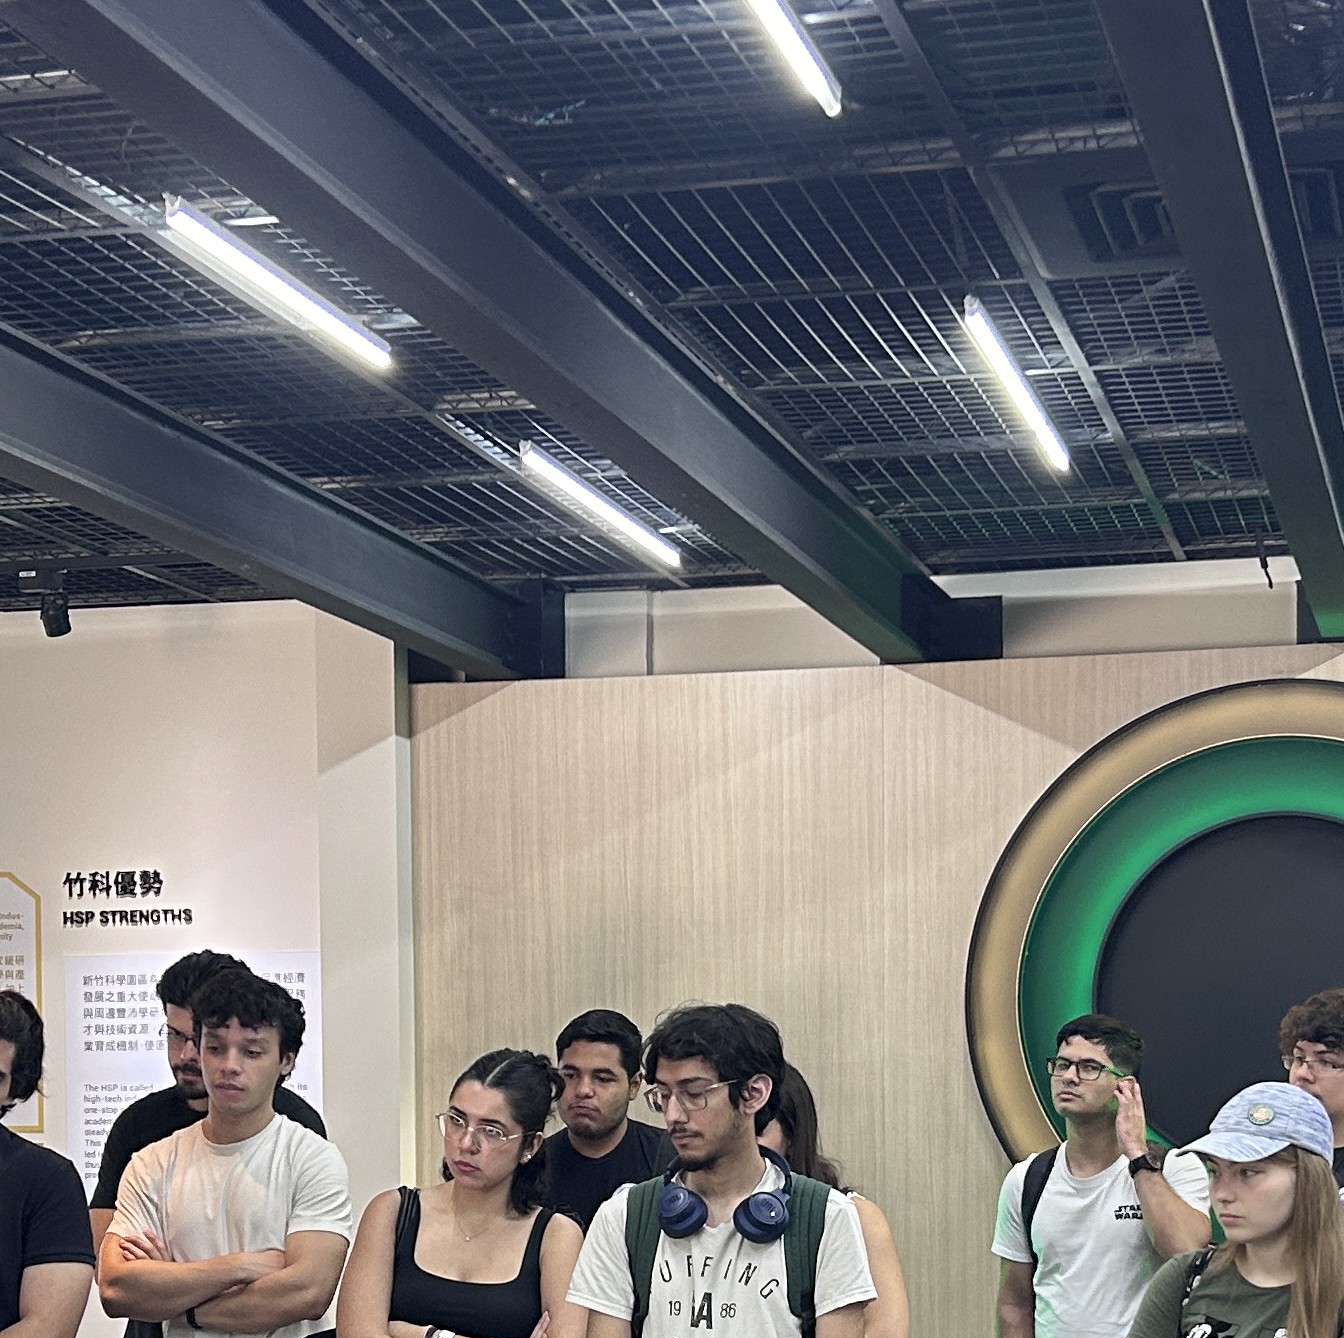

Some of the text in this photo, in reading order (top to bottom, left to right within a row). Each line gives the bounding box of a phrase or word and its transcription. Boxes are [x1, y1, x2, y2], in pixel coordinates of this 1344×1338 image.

[62, 870, 163, 899] 竹科優勢
[62, 909, 193, 927] HSP STRENGTHS
[84, 1084, 99, 1092] The
[101, 1084, 118, 1092] HSP
[120, 1084, 128, 1092] is
[83, 1095, 123, 1104] high-tech
[668, 1300, 682, 1316] 19
[719, 1303, 737, 1319] 86
